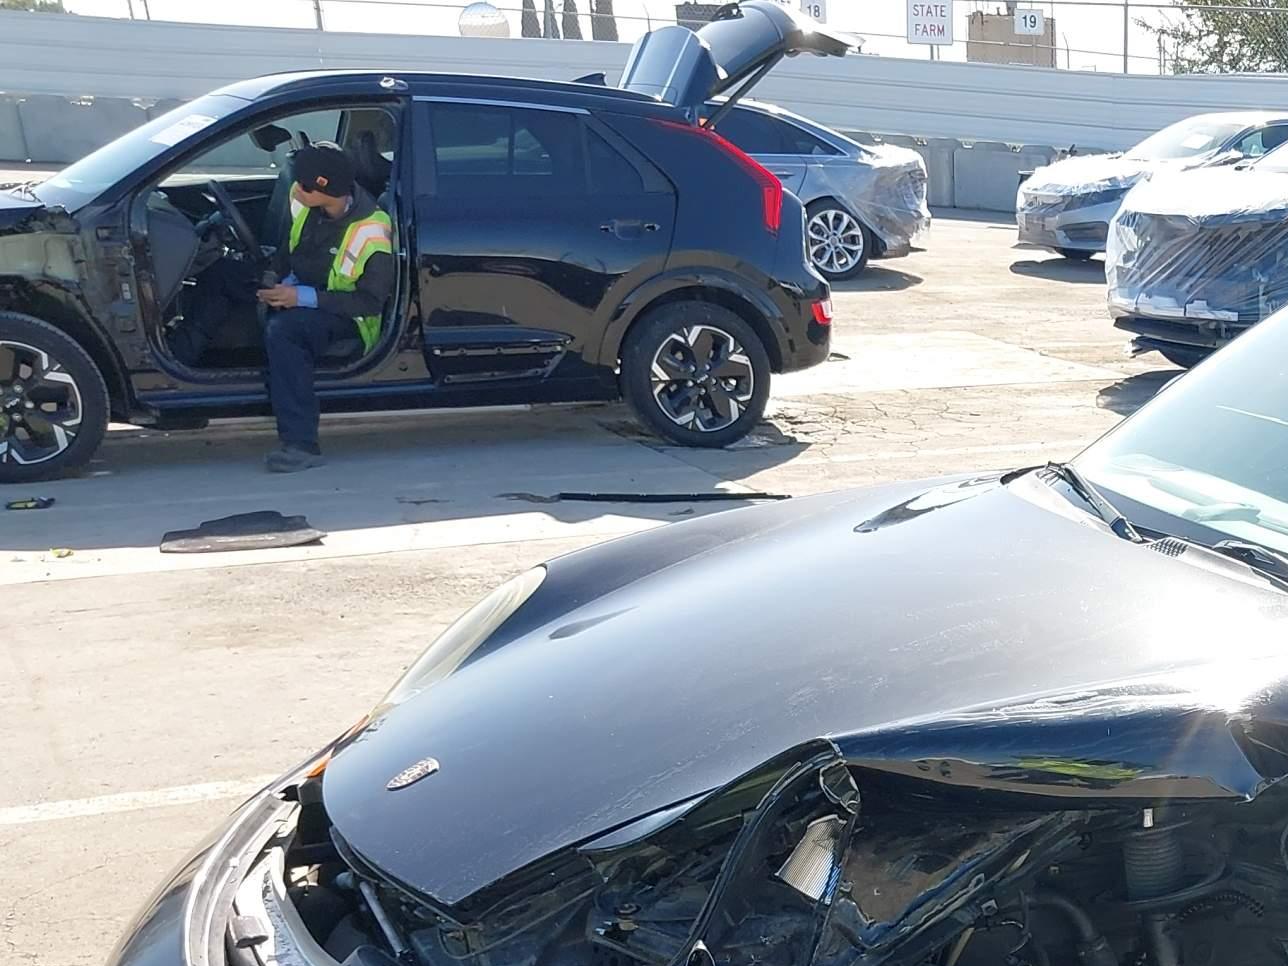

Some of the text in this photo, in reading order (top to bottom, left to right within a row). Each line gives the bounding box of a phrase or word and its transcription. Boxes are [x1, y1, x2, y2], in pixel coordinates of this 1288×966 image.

[806, 4, 821, 18] 18
[912, 4, 947, 18] STATE
[1021, 14, 1037, 28] 19
[914, 23, 945, 37] FARM
